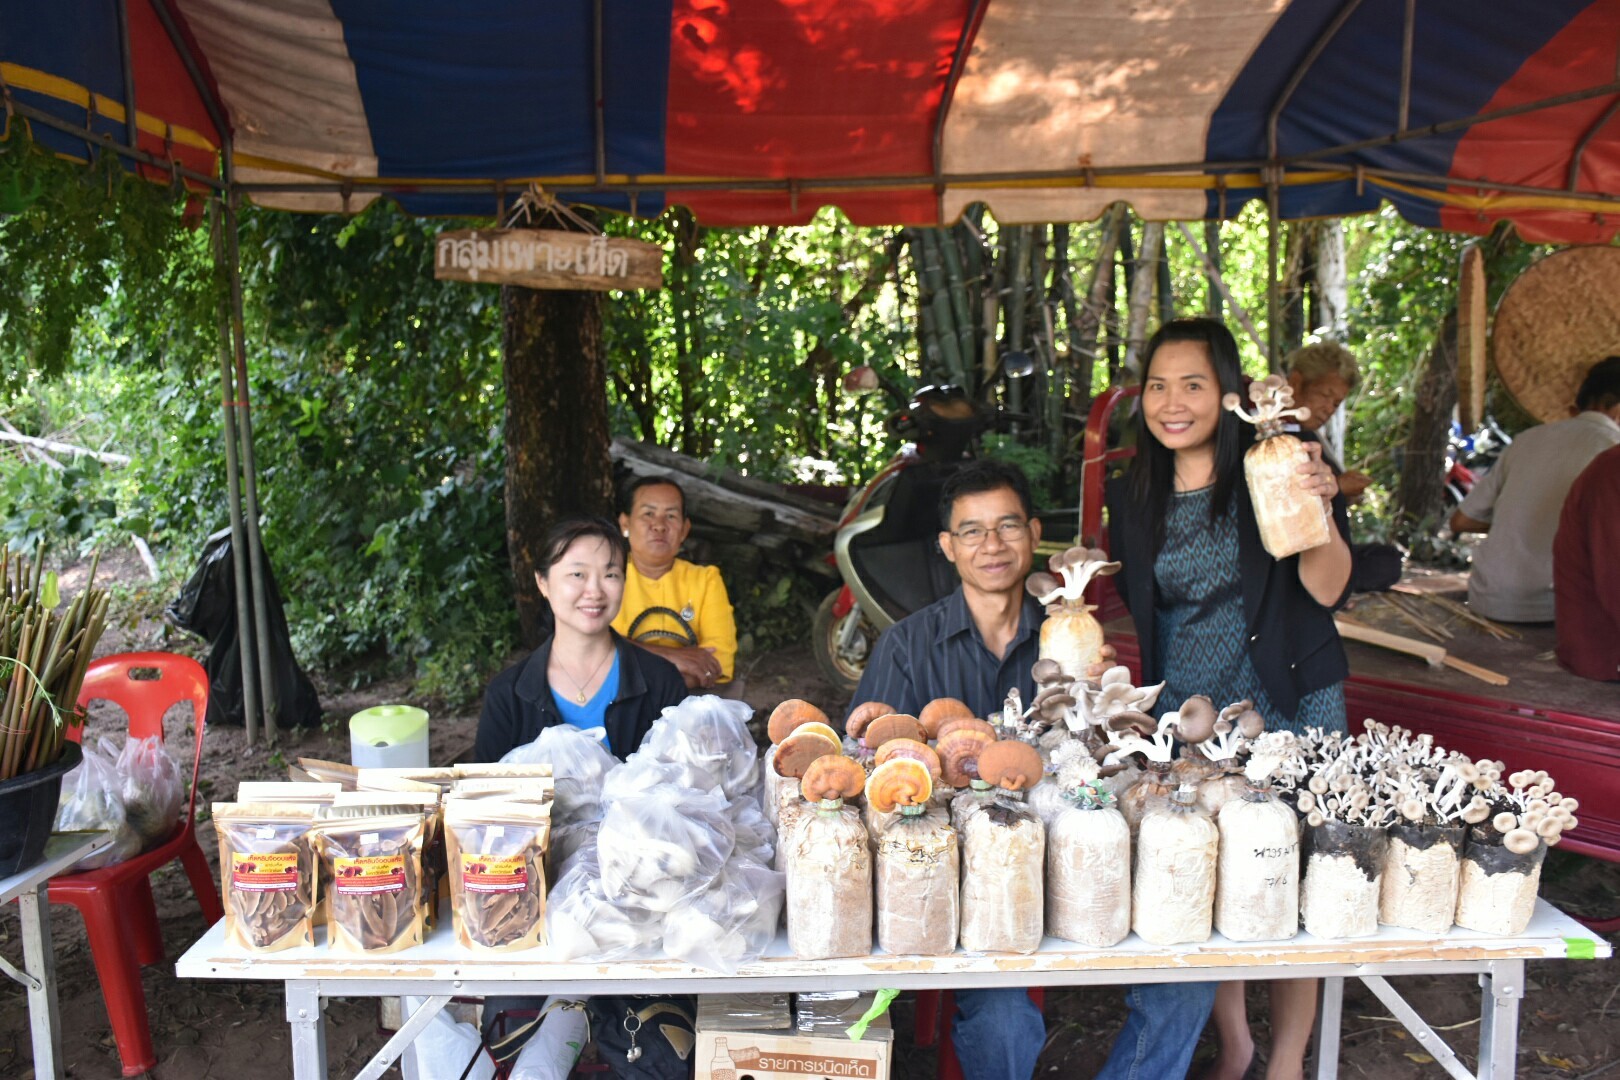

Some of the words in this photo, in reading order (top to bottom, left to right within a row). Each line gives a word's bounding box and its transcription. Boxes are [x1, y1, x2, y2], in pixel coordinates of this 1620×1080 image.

[438, 231, 629, 280] กลุ่มเพาะเห็ด
[758, 1057, 870, 1077] รายการชนิดเห็ด
